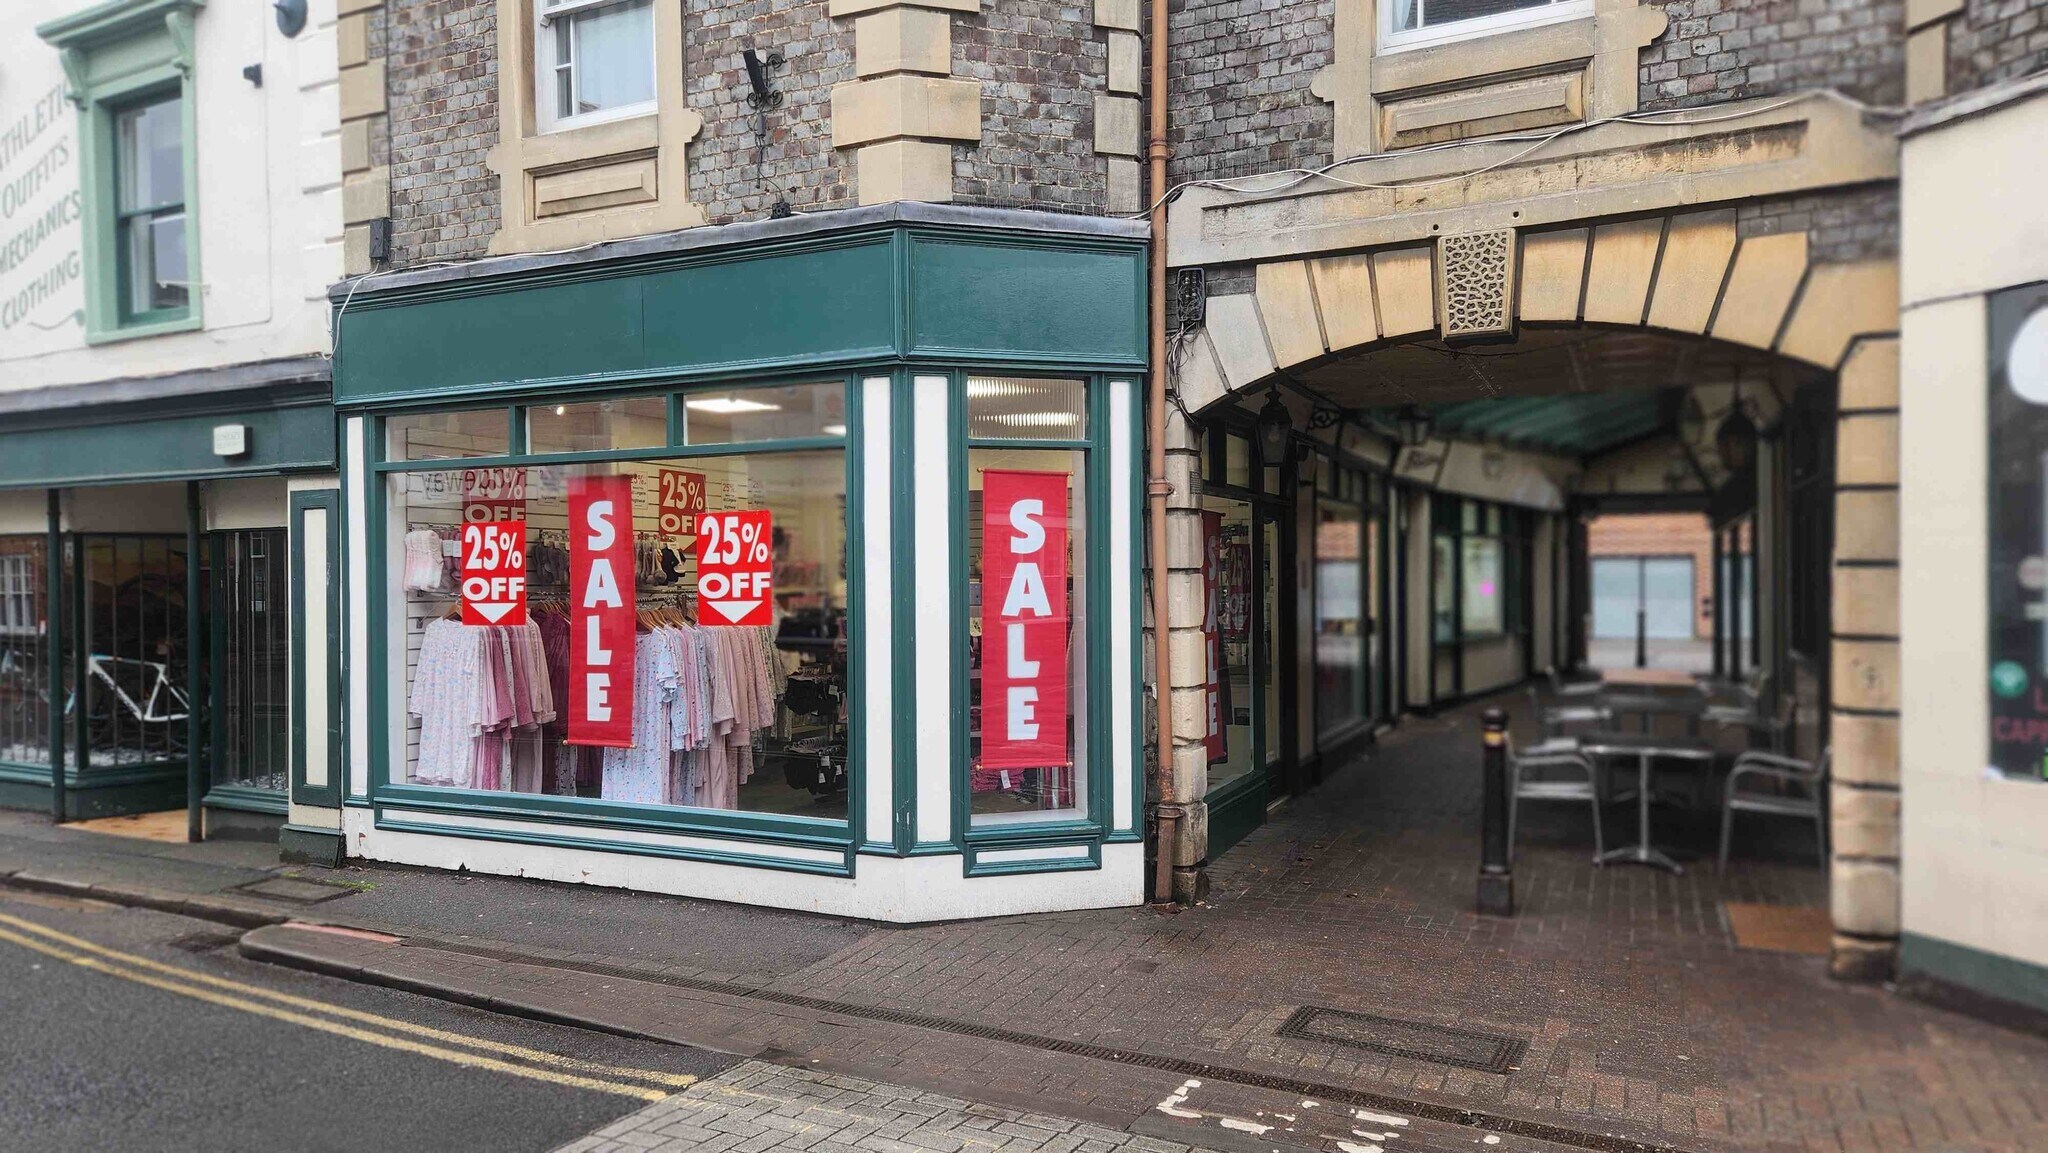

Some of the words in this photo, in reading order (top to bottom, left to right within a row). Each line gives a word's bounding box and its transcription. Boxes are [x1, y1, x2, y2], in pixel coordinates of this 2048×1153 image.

[2, 135, 69, 219] OUTFITS
[2, 250, 80, 330] CLOTHING
[662, 472, 703, 510] 25%
[464, 525, 522, 570] 25%
[660, 513, 697, 533] OF
[700, 516, 768, 565] 25%
[463, 577, 524, 600] OFF
[698, 572, 771, 599] OFF
[583, 500, 623, 722] SALE
[1001, 499, 1053, 741] SALE
[1206, 535, 1219, 737] SALE
